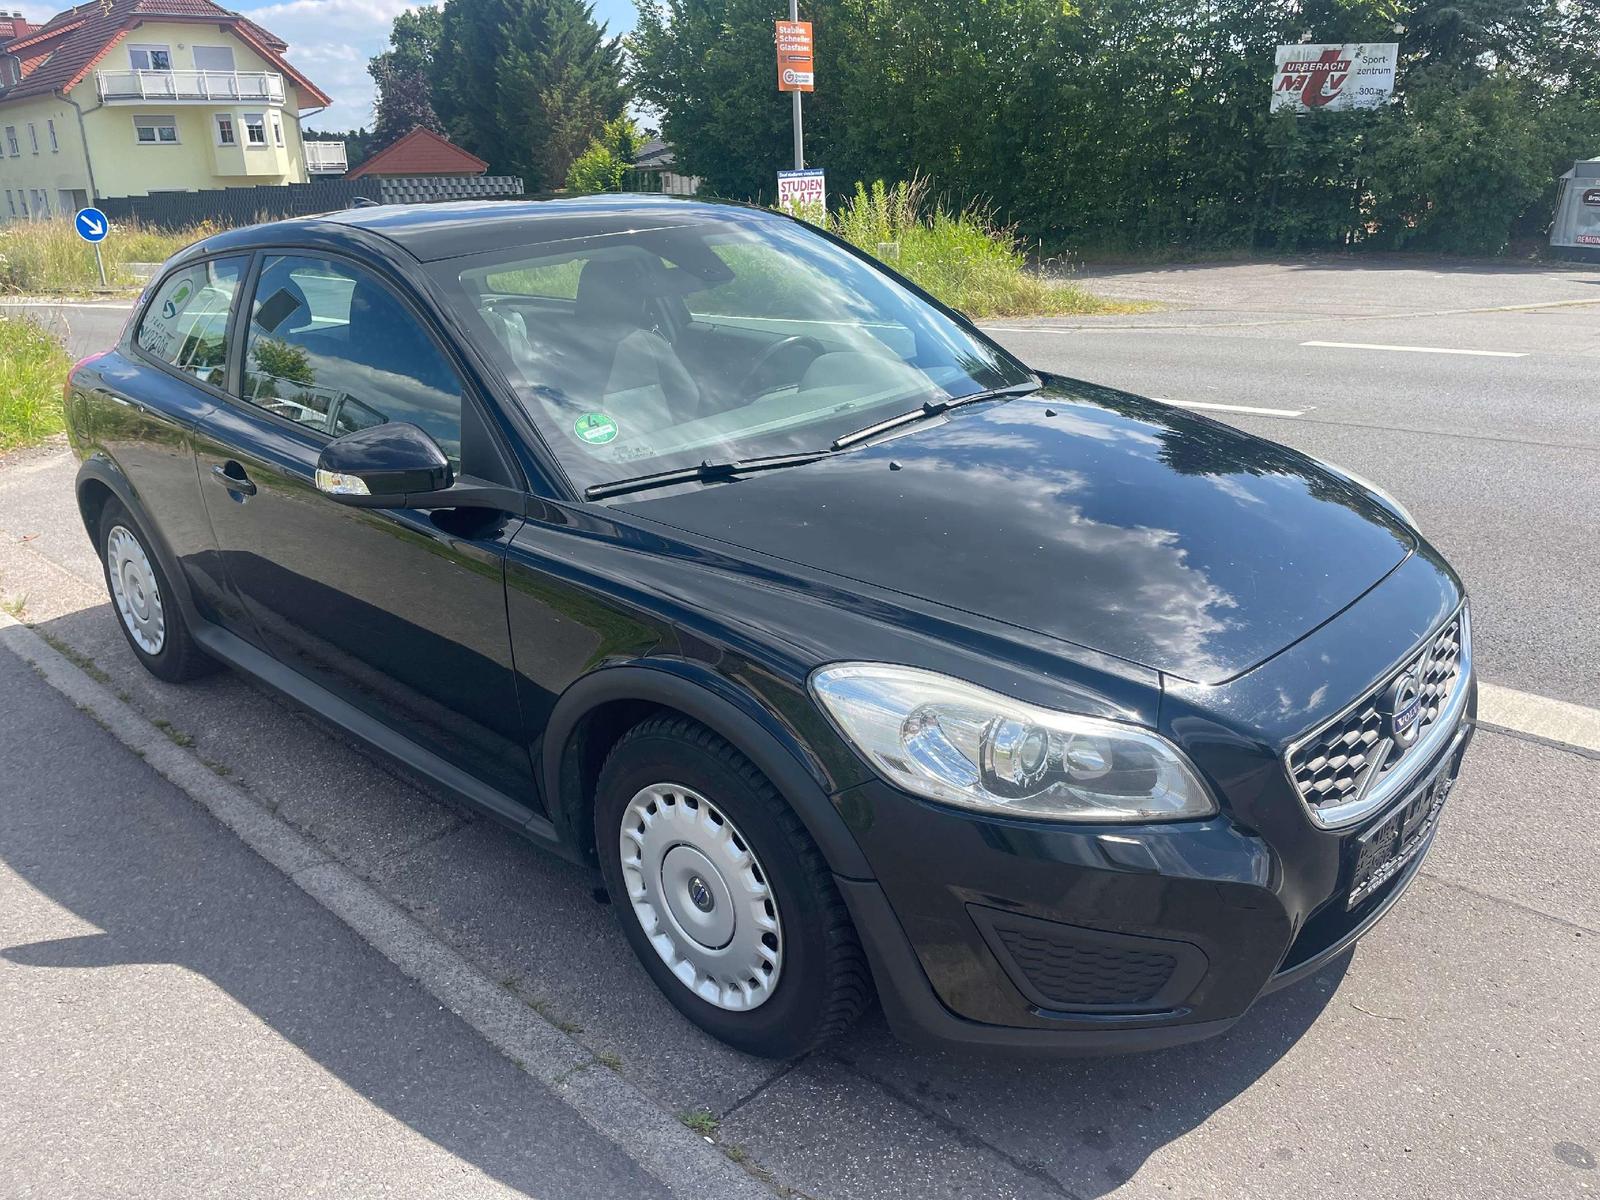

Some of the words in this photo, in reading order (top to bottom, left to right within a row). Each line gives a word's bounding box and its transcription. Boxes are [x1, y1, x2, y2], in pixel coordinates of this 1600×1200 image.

[1362, 56, 1389, 65] Sport-
[1287, 62, 1345, 71] URBERACH
[781, 179, 823, 193] STUDIEN
